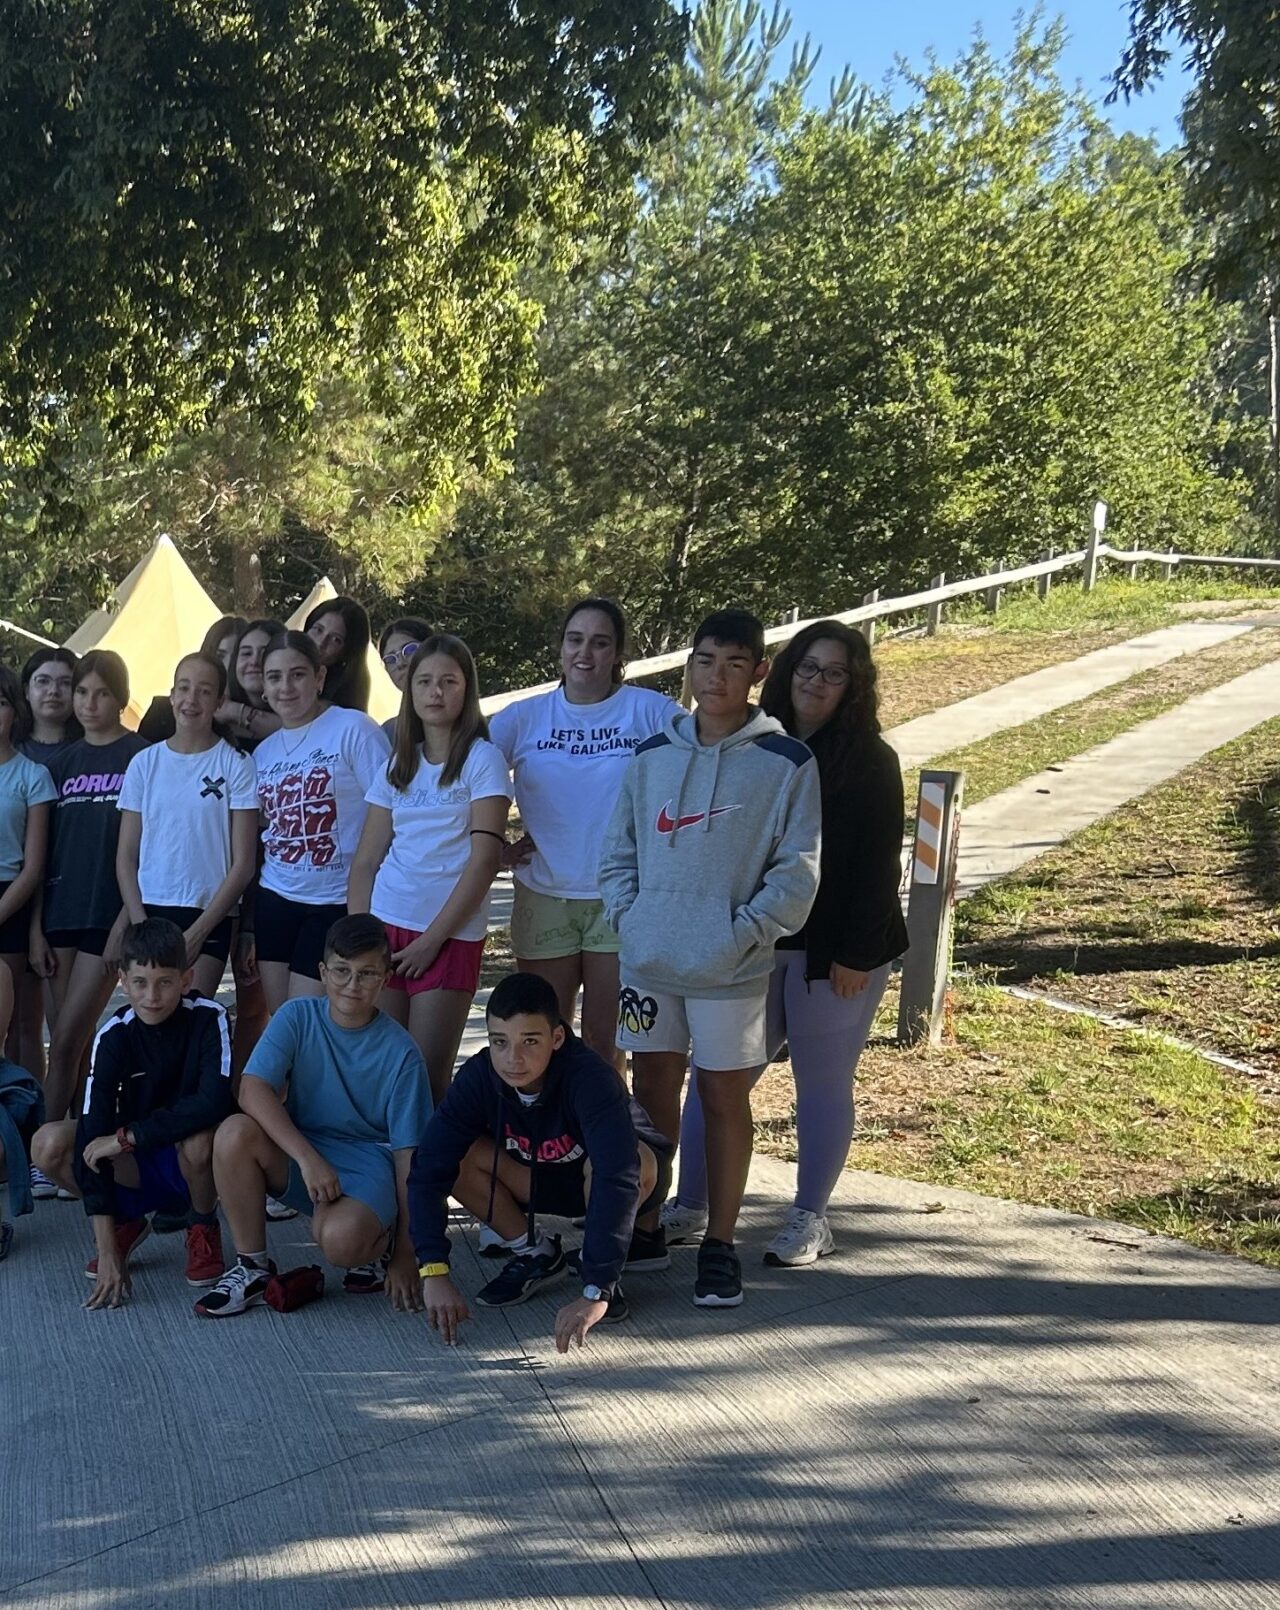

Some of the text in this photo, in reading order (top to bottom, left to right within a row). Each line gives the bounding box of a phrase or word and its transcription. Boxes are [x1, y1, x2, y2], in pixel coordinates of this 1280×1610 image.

[550, 726, 621, 742] LET'S LIVE
[537, 739, 566, 751] LIKE
